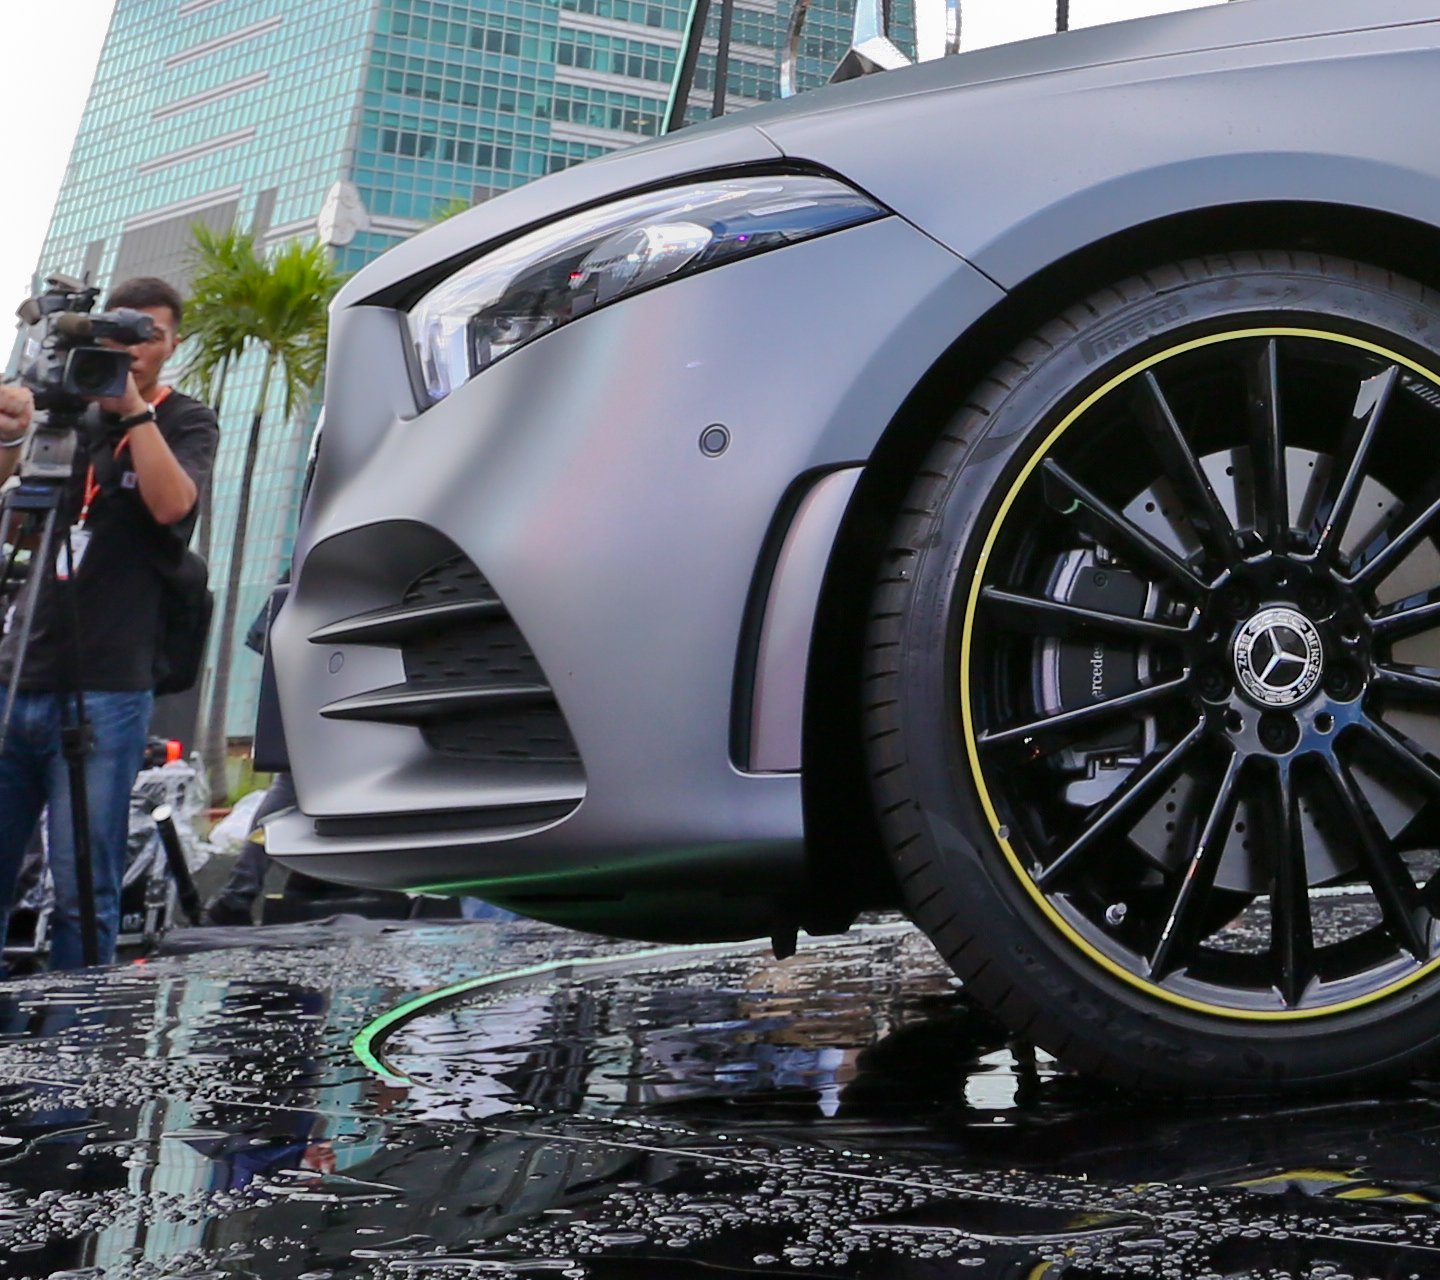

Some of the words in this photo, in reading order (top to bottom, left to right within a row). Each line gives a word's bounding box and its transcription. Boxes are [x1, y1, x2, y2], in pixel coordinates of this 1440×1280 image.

[1076, 293, 1189, 366] PIRELLI
[1237, 633, 1253, 668] BENZ
[1297, 629, 1320, 694] MERCEDES
